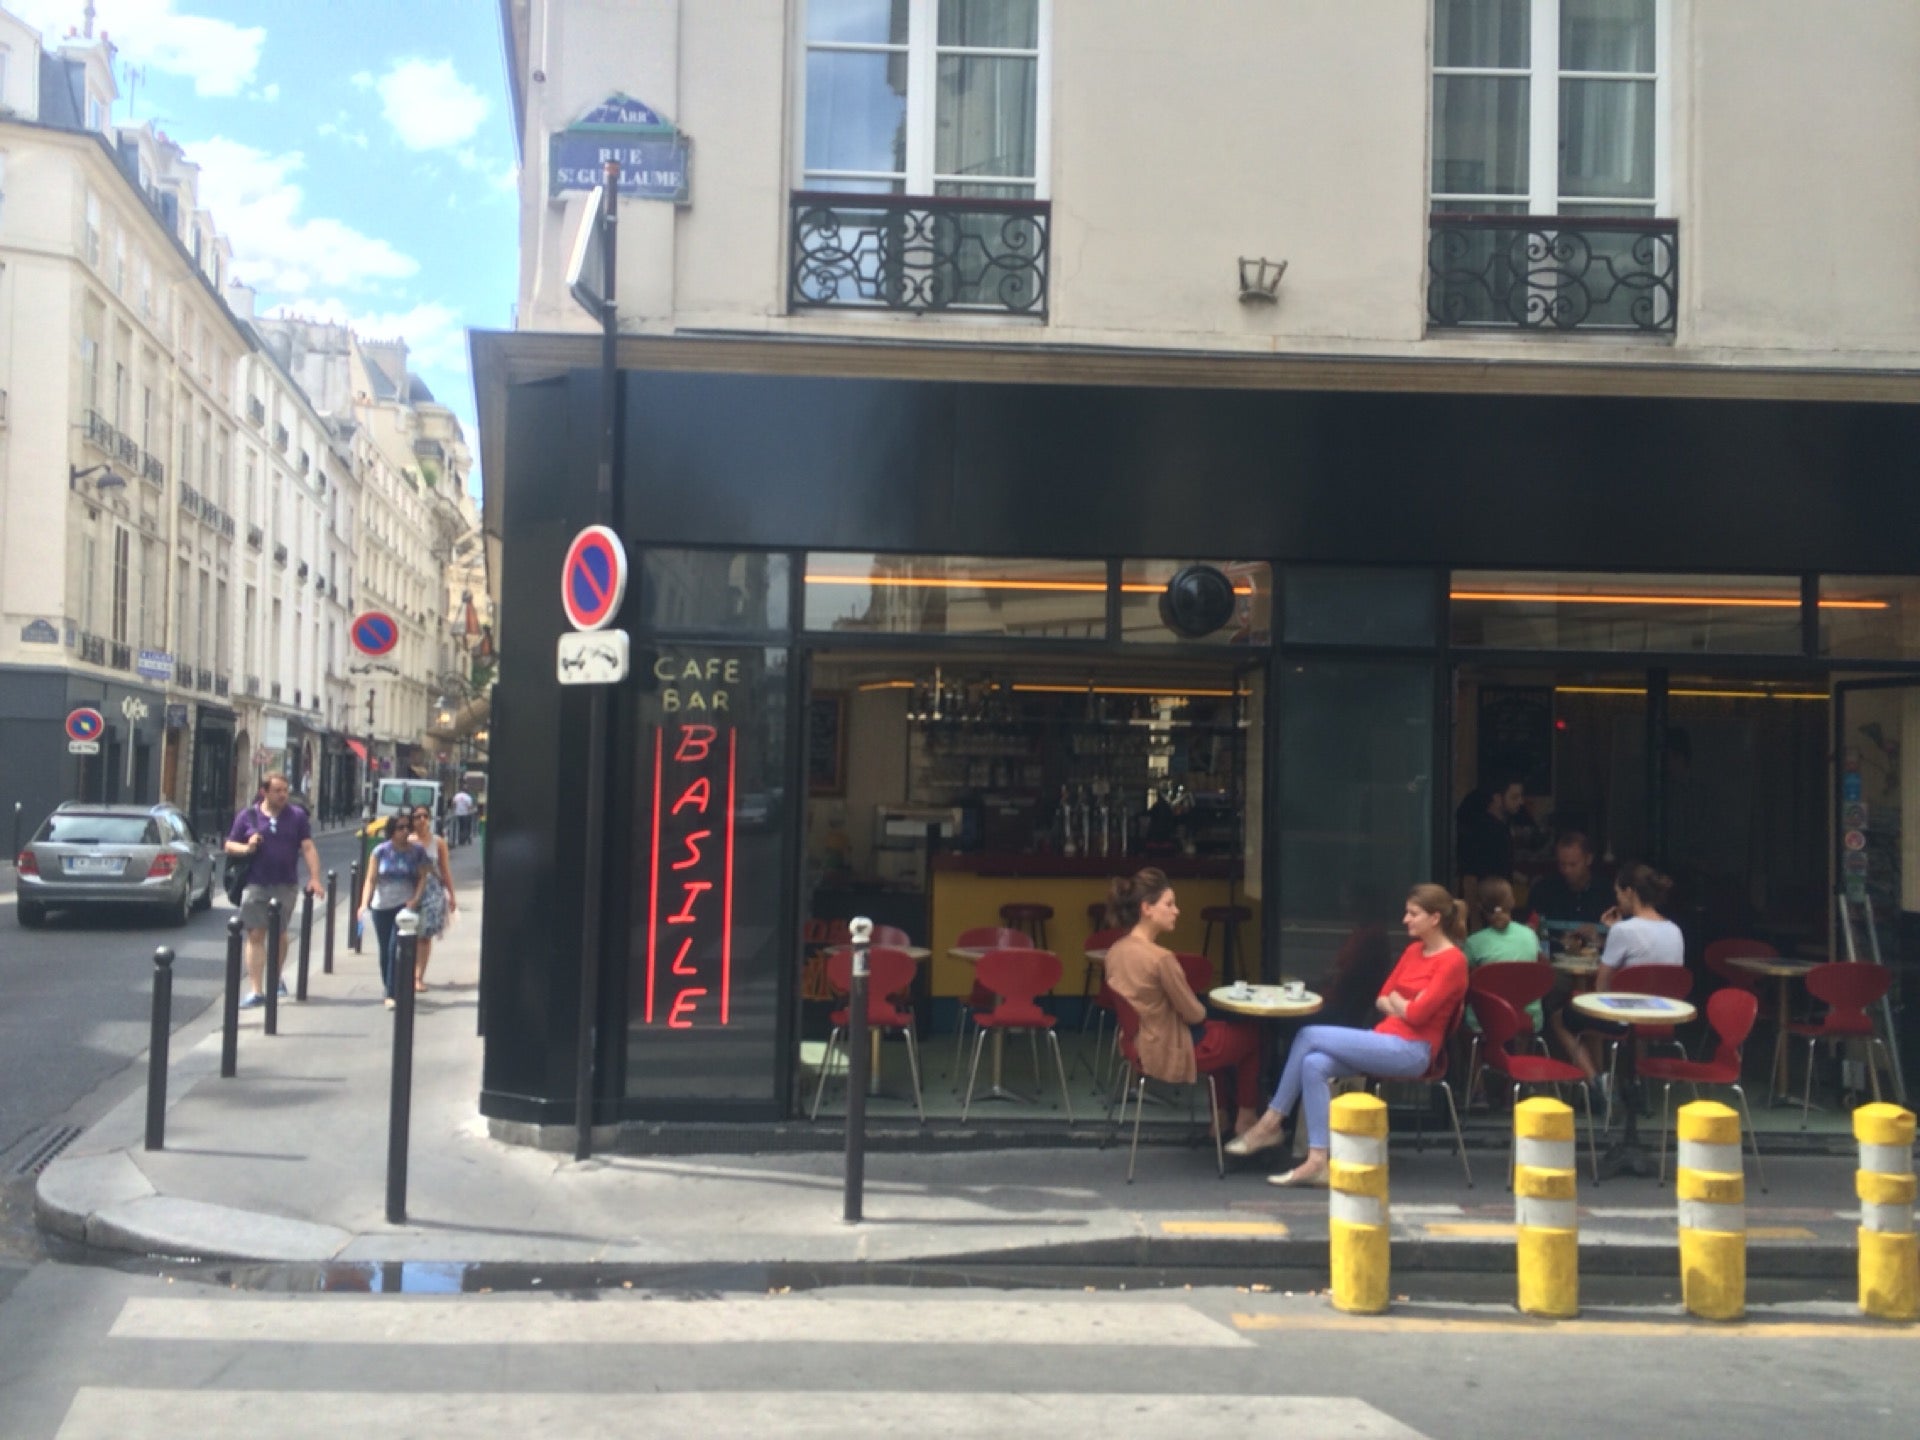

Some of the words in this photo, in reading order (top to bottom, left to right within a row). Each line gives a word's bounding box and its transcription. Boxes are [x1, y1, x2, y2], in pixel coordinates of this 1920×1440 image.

[598, 148, 642, 165] RUE
[577, 168, 681, 187] GUILAUME
[653, 656, 741, 683] CAFE
[662, 687, 730, 712] BAR
[667, 724, 718, 1029] BASILE
